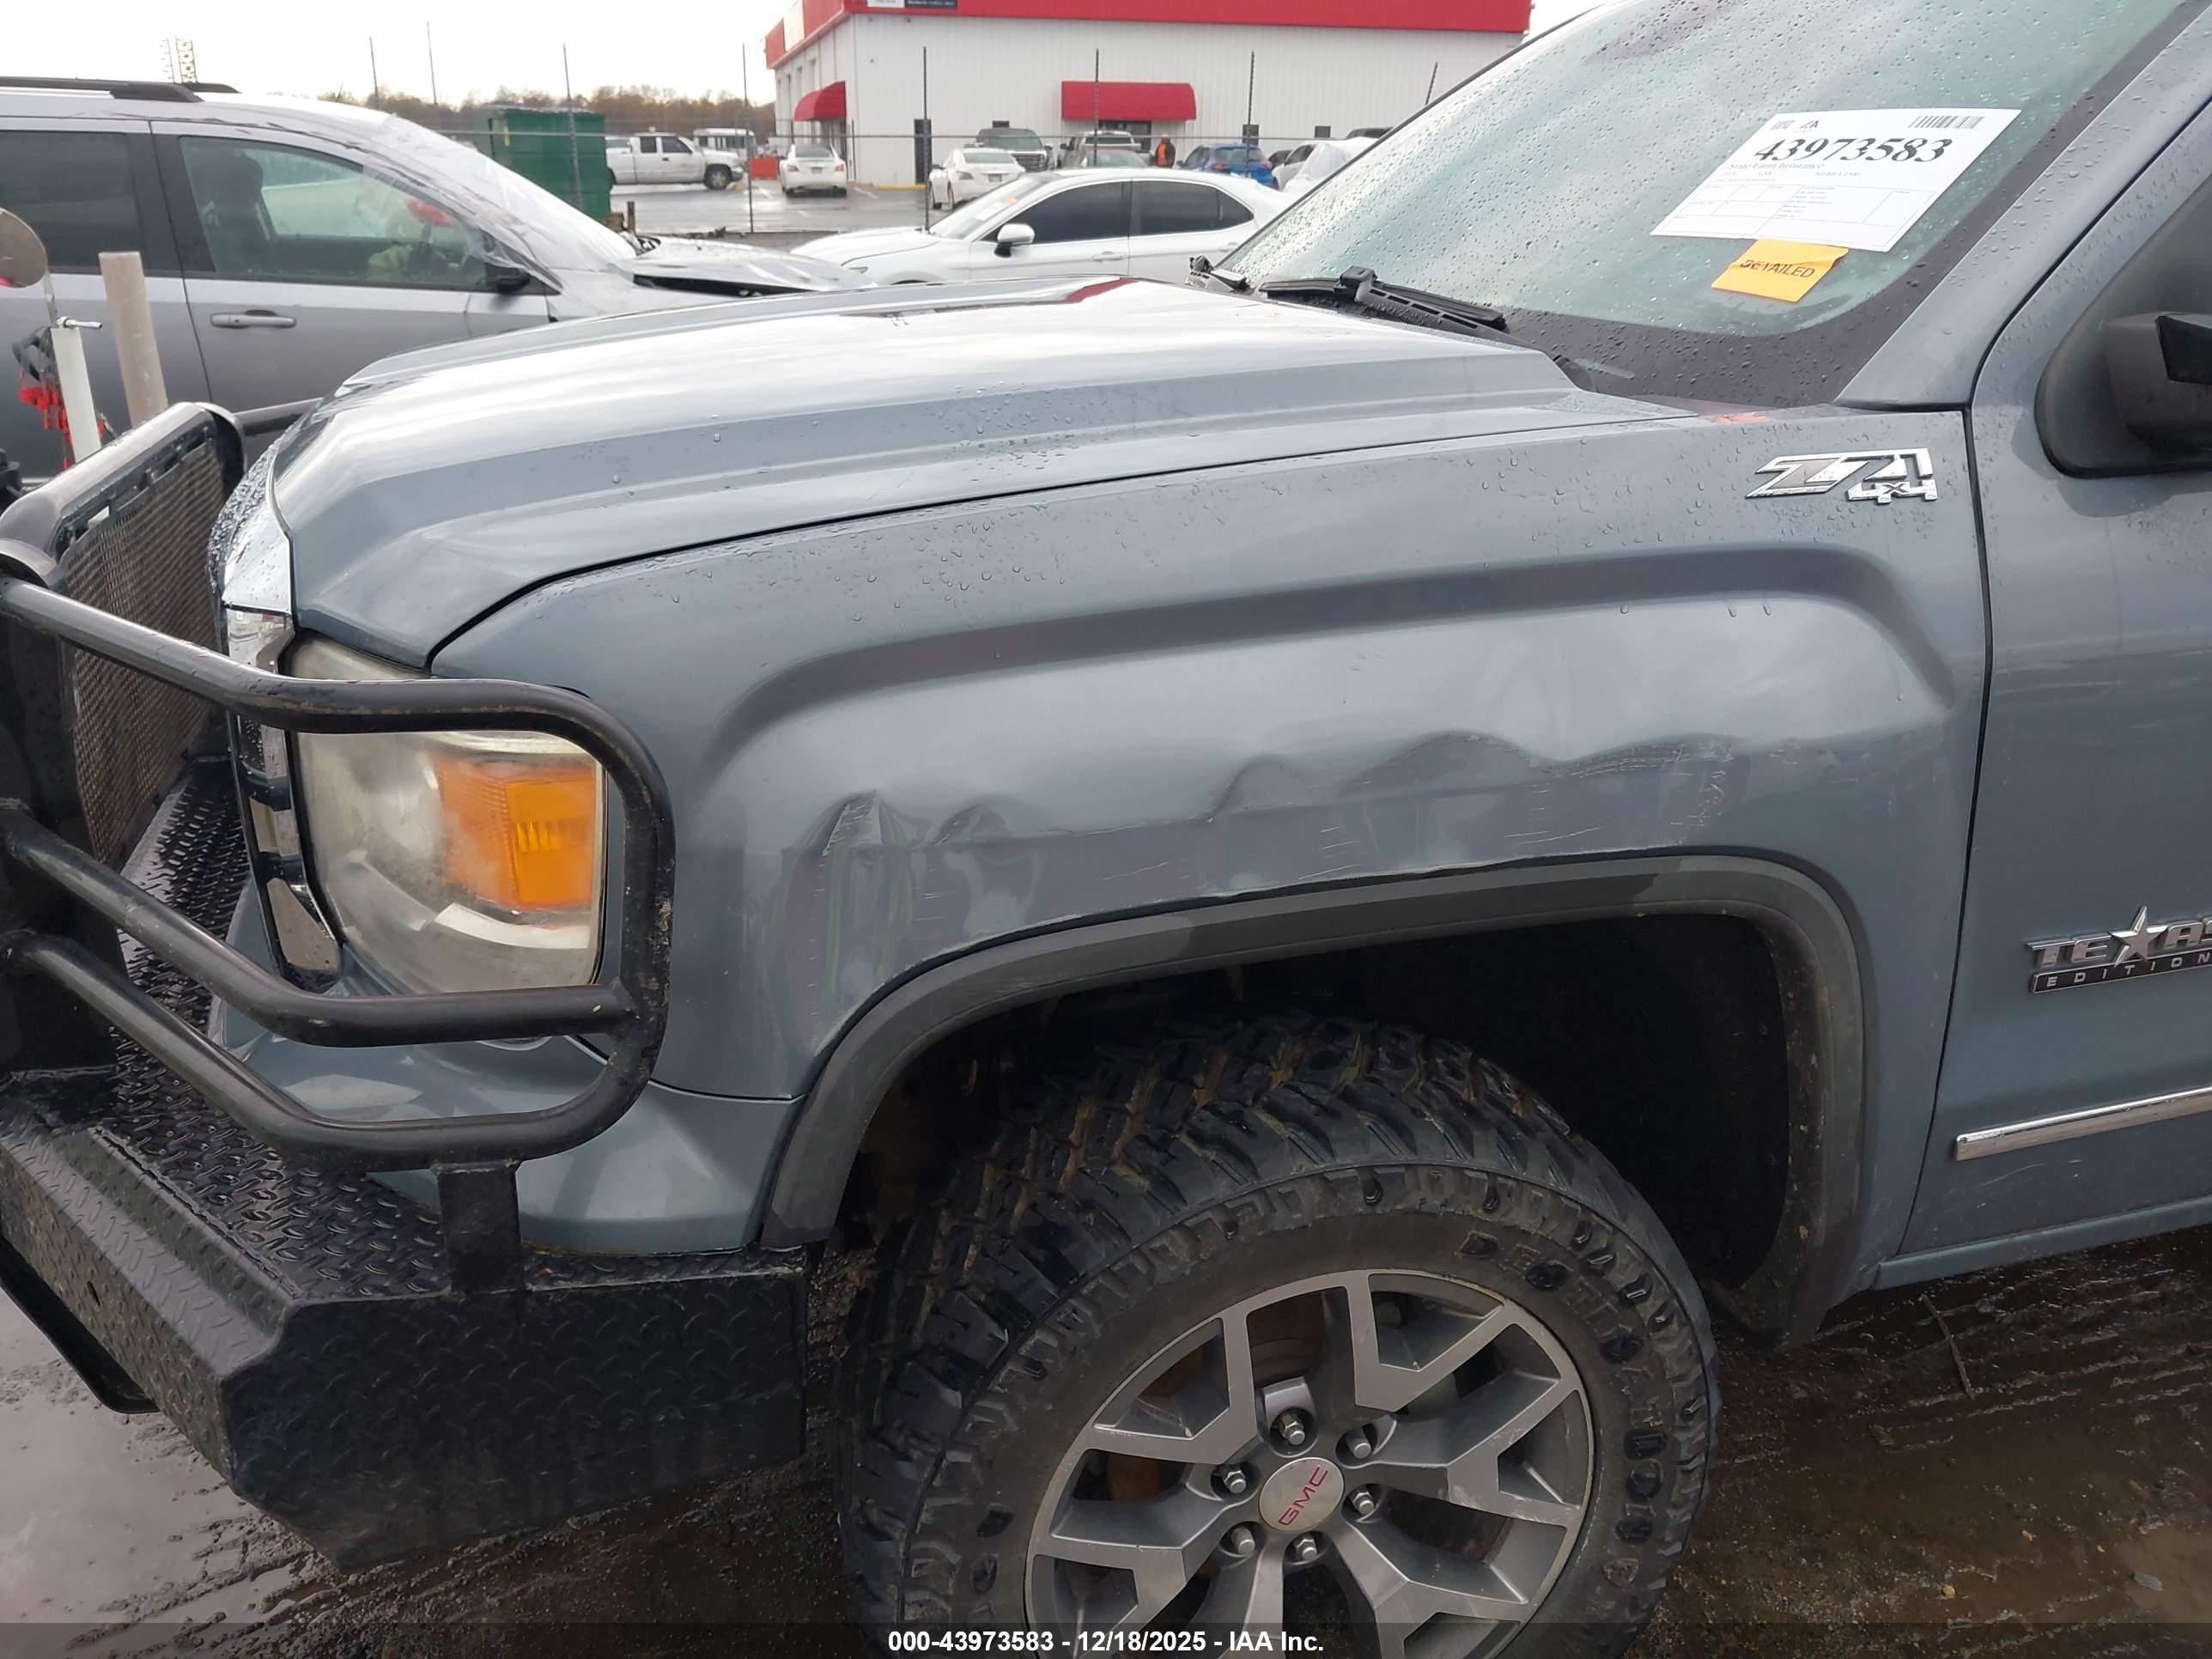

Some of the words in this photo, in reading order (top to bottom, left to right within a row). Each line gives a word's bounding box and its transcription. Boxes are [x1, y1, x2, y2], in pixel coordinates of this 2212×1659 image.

[1754, 137, 1952, 162] 43973583
[1740, 259, 1814, 278] DETAILED
[1745, 448, 1933, 498] Z71
[2046, 952, 2210, 988] EDITION
[1278, 1464, 1328, 1525] GMC
